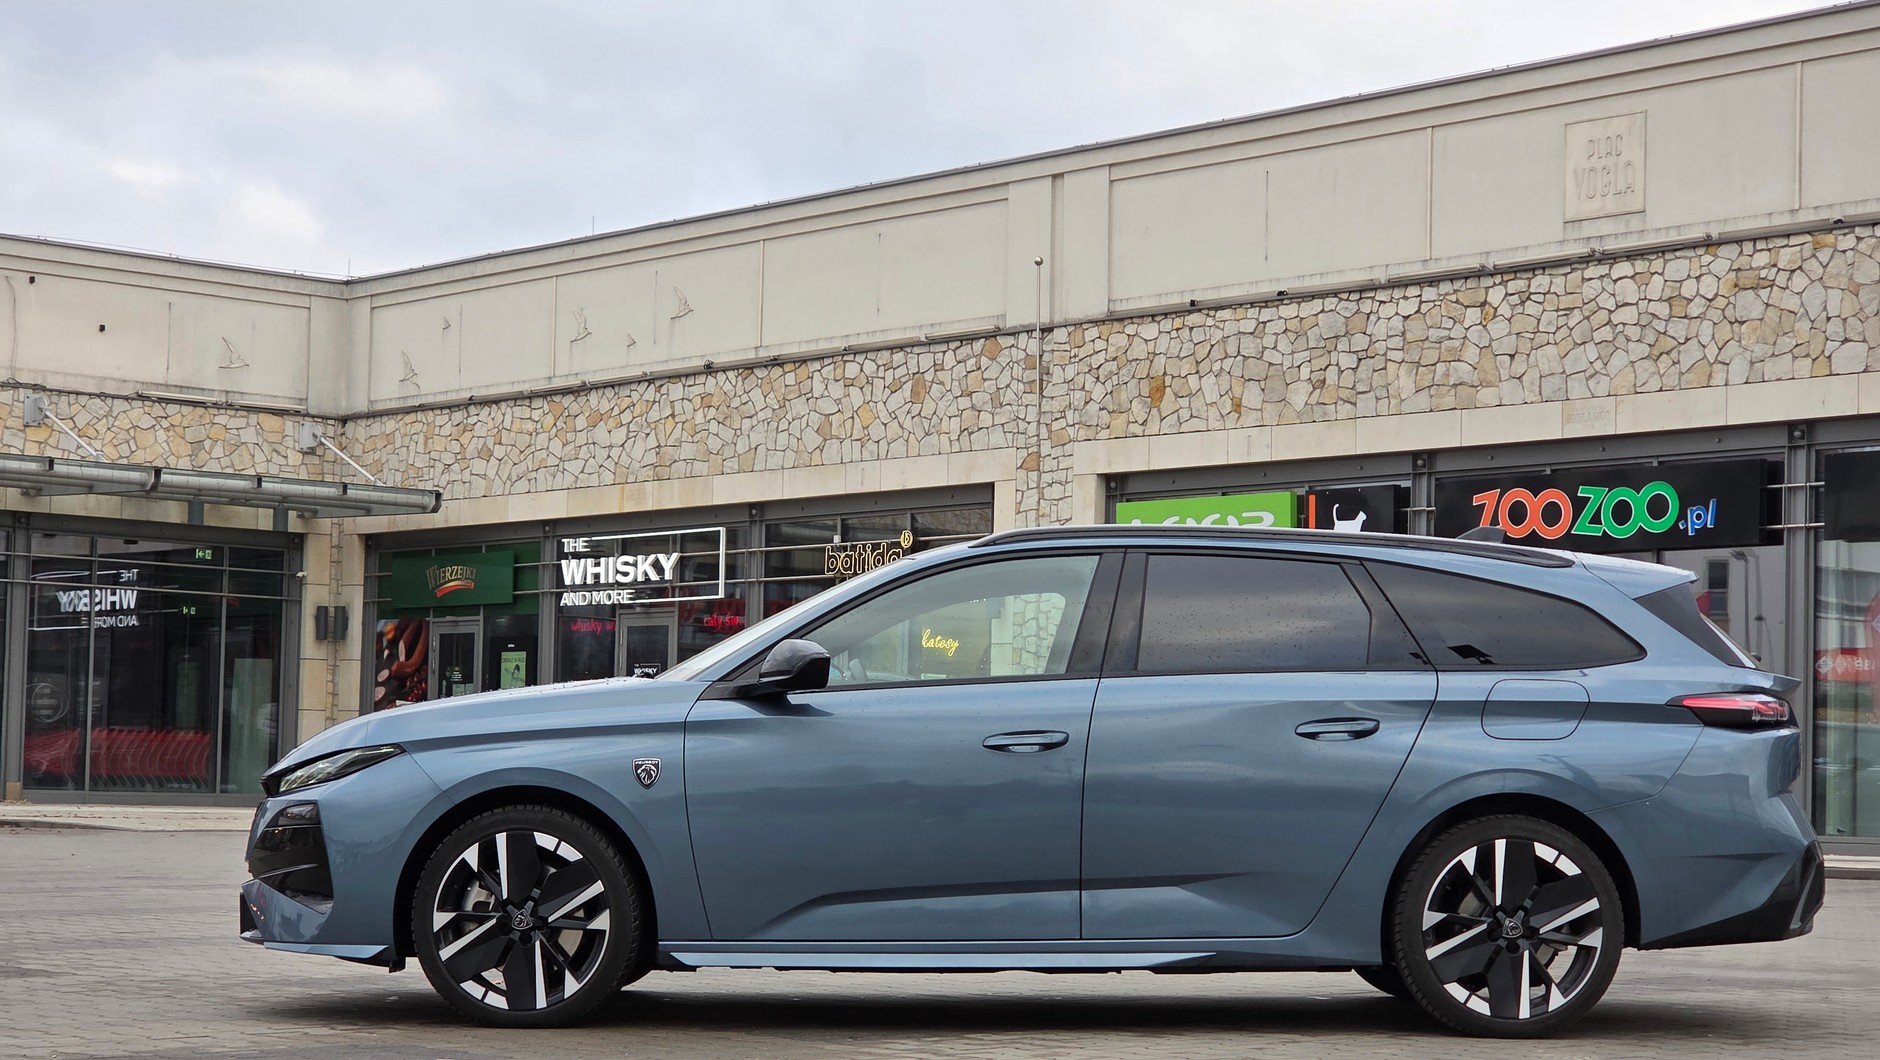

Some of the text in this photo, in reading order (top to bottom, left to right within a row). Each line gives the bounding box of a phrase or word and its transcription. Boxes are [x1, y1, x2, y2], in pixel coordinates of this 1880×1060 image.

[1587, 134, 1623, 160] PLAC
[1573, 161, 1635, 200] VOGLA
[561, 537, 591, 552] THE
[426, 565, 476, 591] WIERZEJKI
[561, 552, 680, 585] WHISKY
[560, 589, 636, 606] AND MORE
[570, 618, 602, 635] whisky
